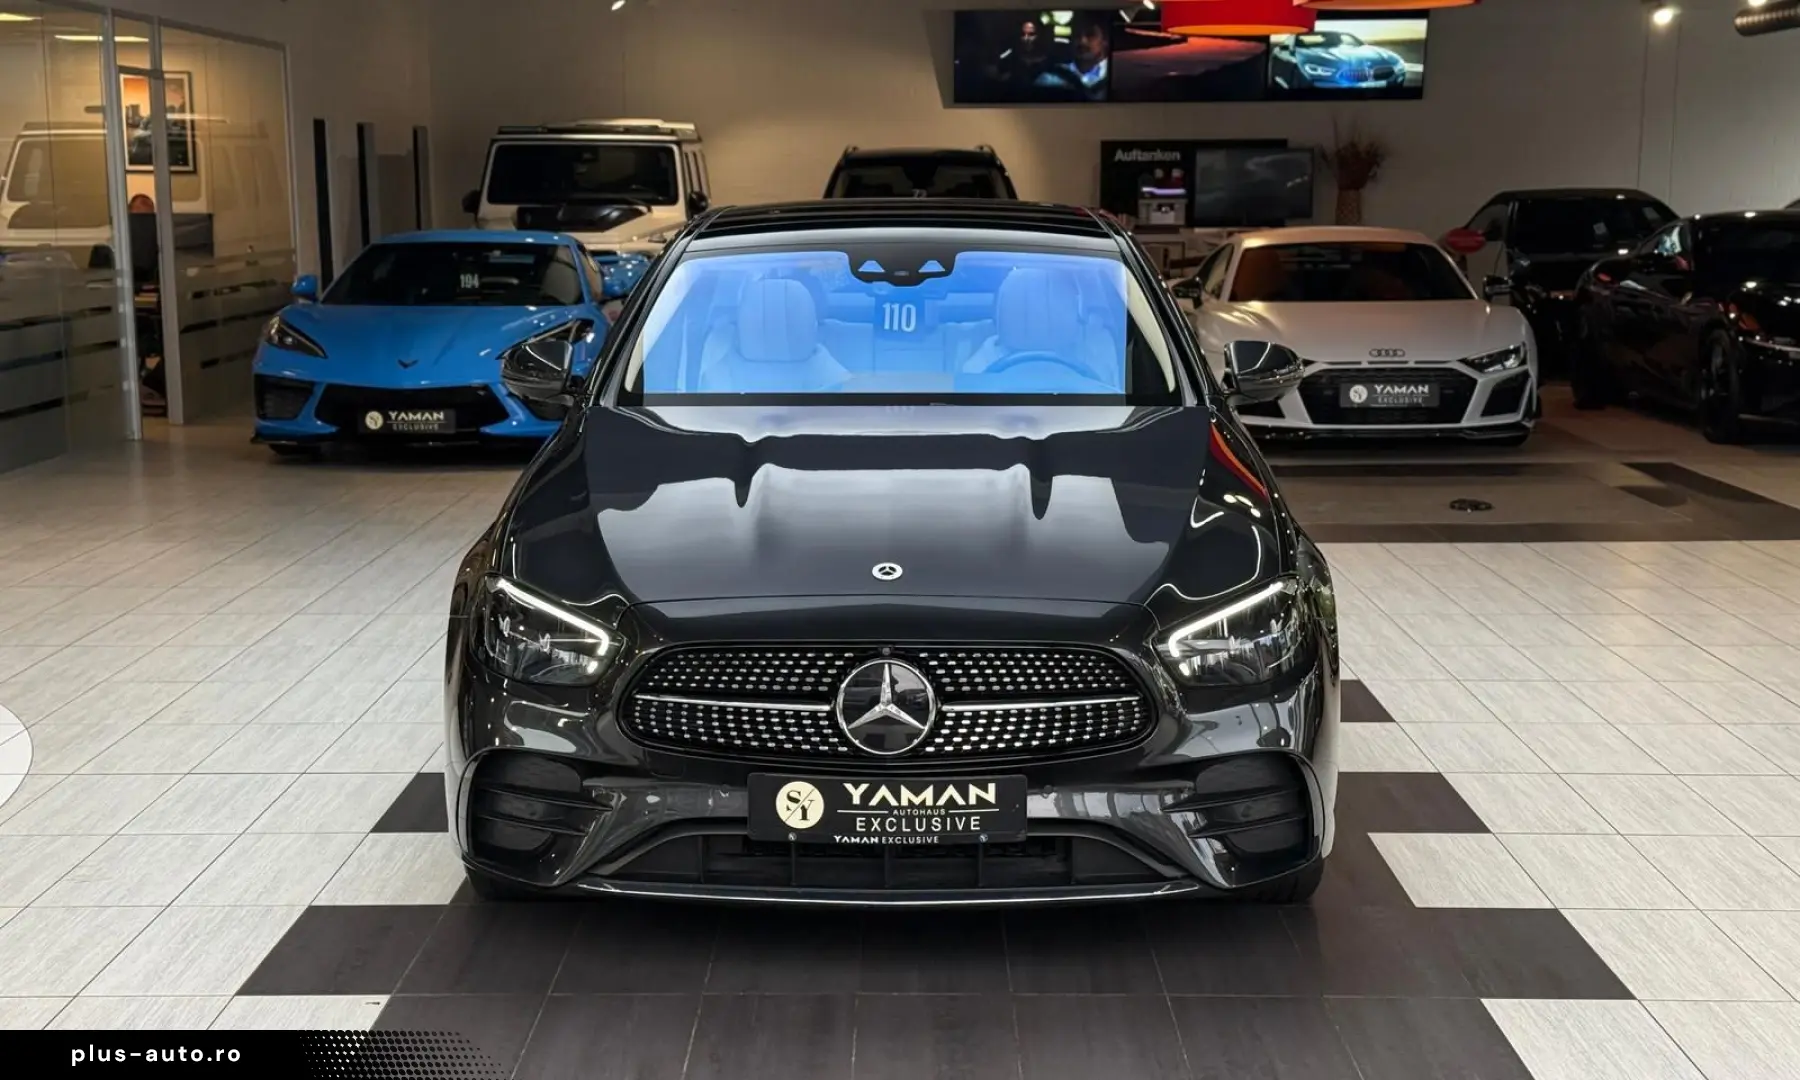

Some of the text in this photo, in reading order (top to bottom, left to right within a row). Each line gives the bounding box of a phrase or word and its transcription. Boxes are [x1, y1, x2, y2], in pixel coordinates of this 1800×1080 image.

[1114, 148, 1181, 162] Auftanken
[882, 302, 917, 333] 110
[1373, 384, 1429, 394] YAMAN
[387, 410, 445, 421] YAMAN
[842, 782, 997, 806] YAMAN
[892, 808, 946, 816] AUTOHAUS
[855, 816, 981, 832] EXCLUSIVE
[833, 835, 940, 845] YAMAN EXCLUSIVE
